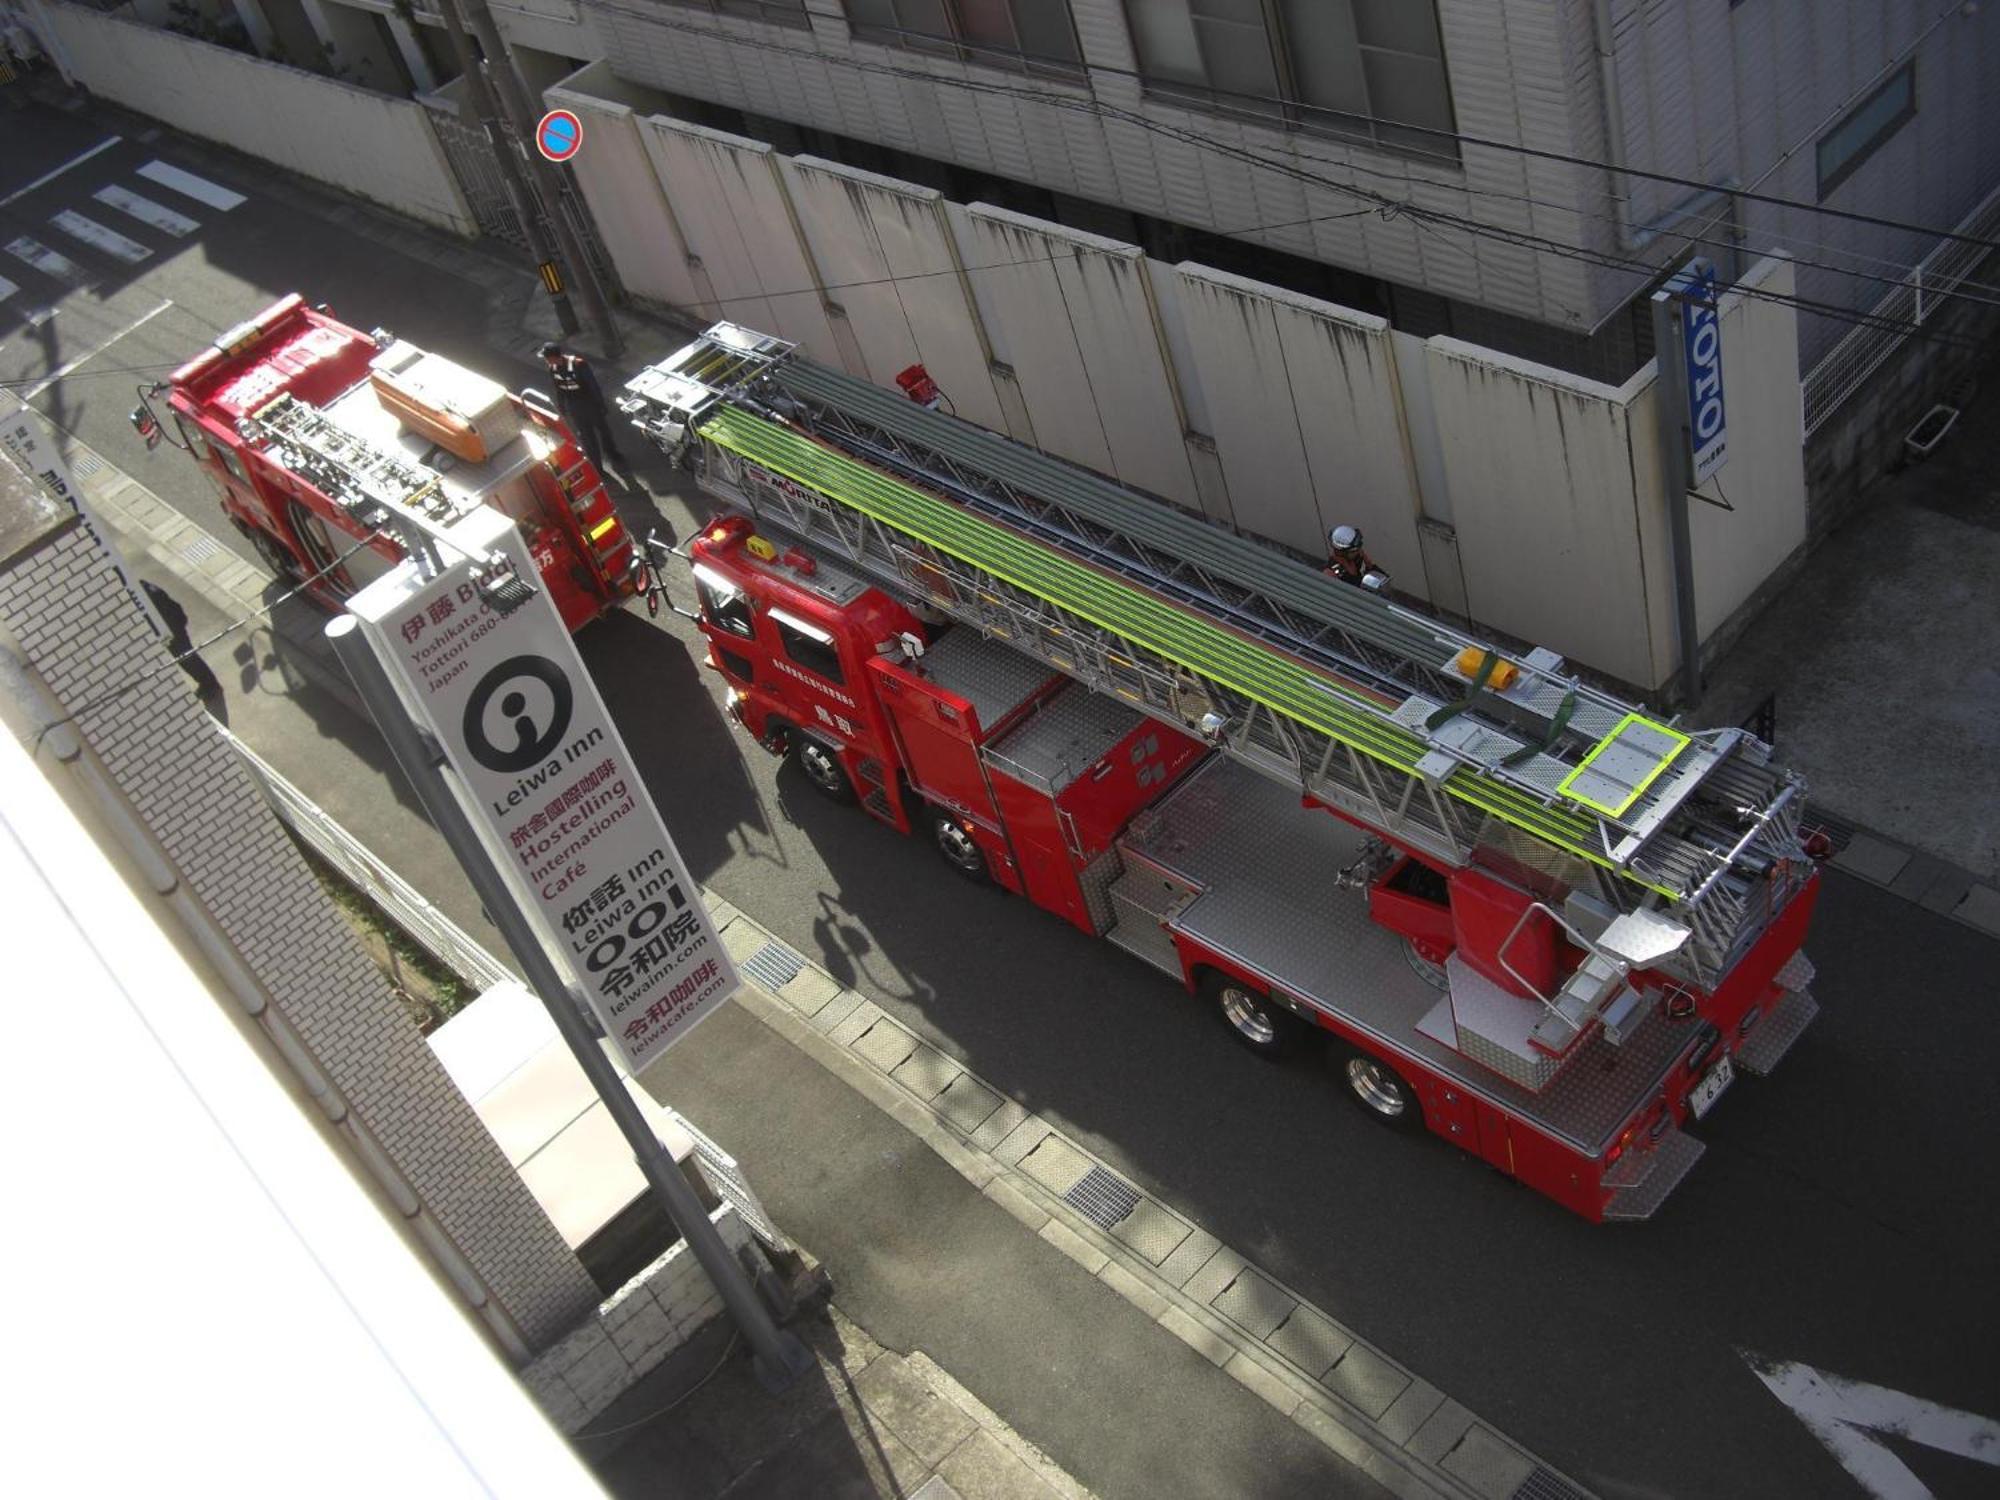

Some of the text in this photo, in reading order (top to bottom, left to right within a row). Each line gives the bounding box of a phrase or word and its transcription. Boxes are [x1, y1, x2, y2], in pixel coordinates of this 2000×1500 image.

[411, 613, 478, 663] Yoshikata
[419, 638, 469, 677] Tottori
[428, 660, 468, 694] Japan
[493, 727, 604, 817] Leiwa Inn
[519, 779, 628, 866] Hostelling
[530, 795, 636, 883] International
[541, 861, 587, 901] Café
[627, 848, 665, 883] Inn
[572, 867, 675, 955] Leiwa Inn
[599, 909, 700, 998] 令和院
[610, 935, 708, 1017] leiwainn.com
[630, 976, 725, 1057] leiwacafe.com
